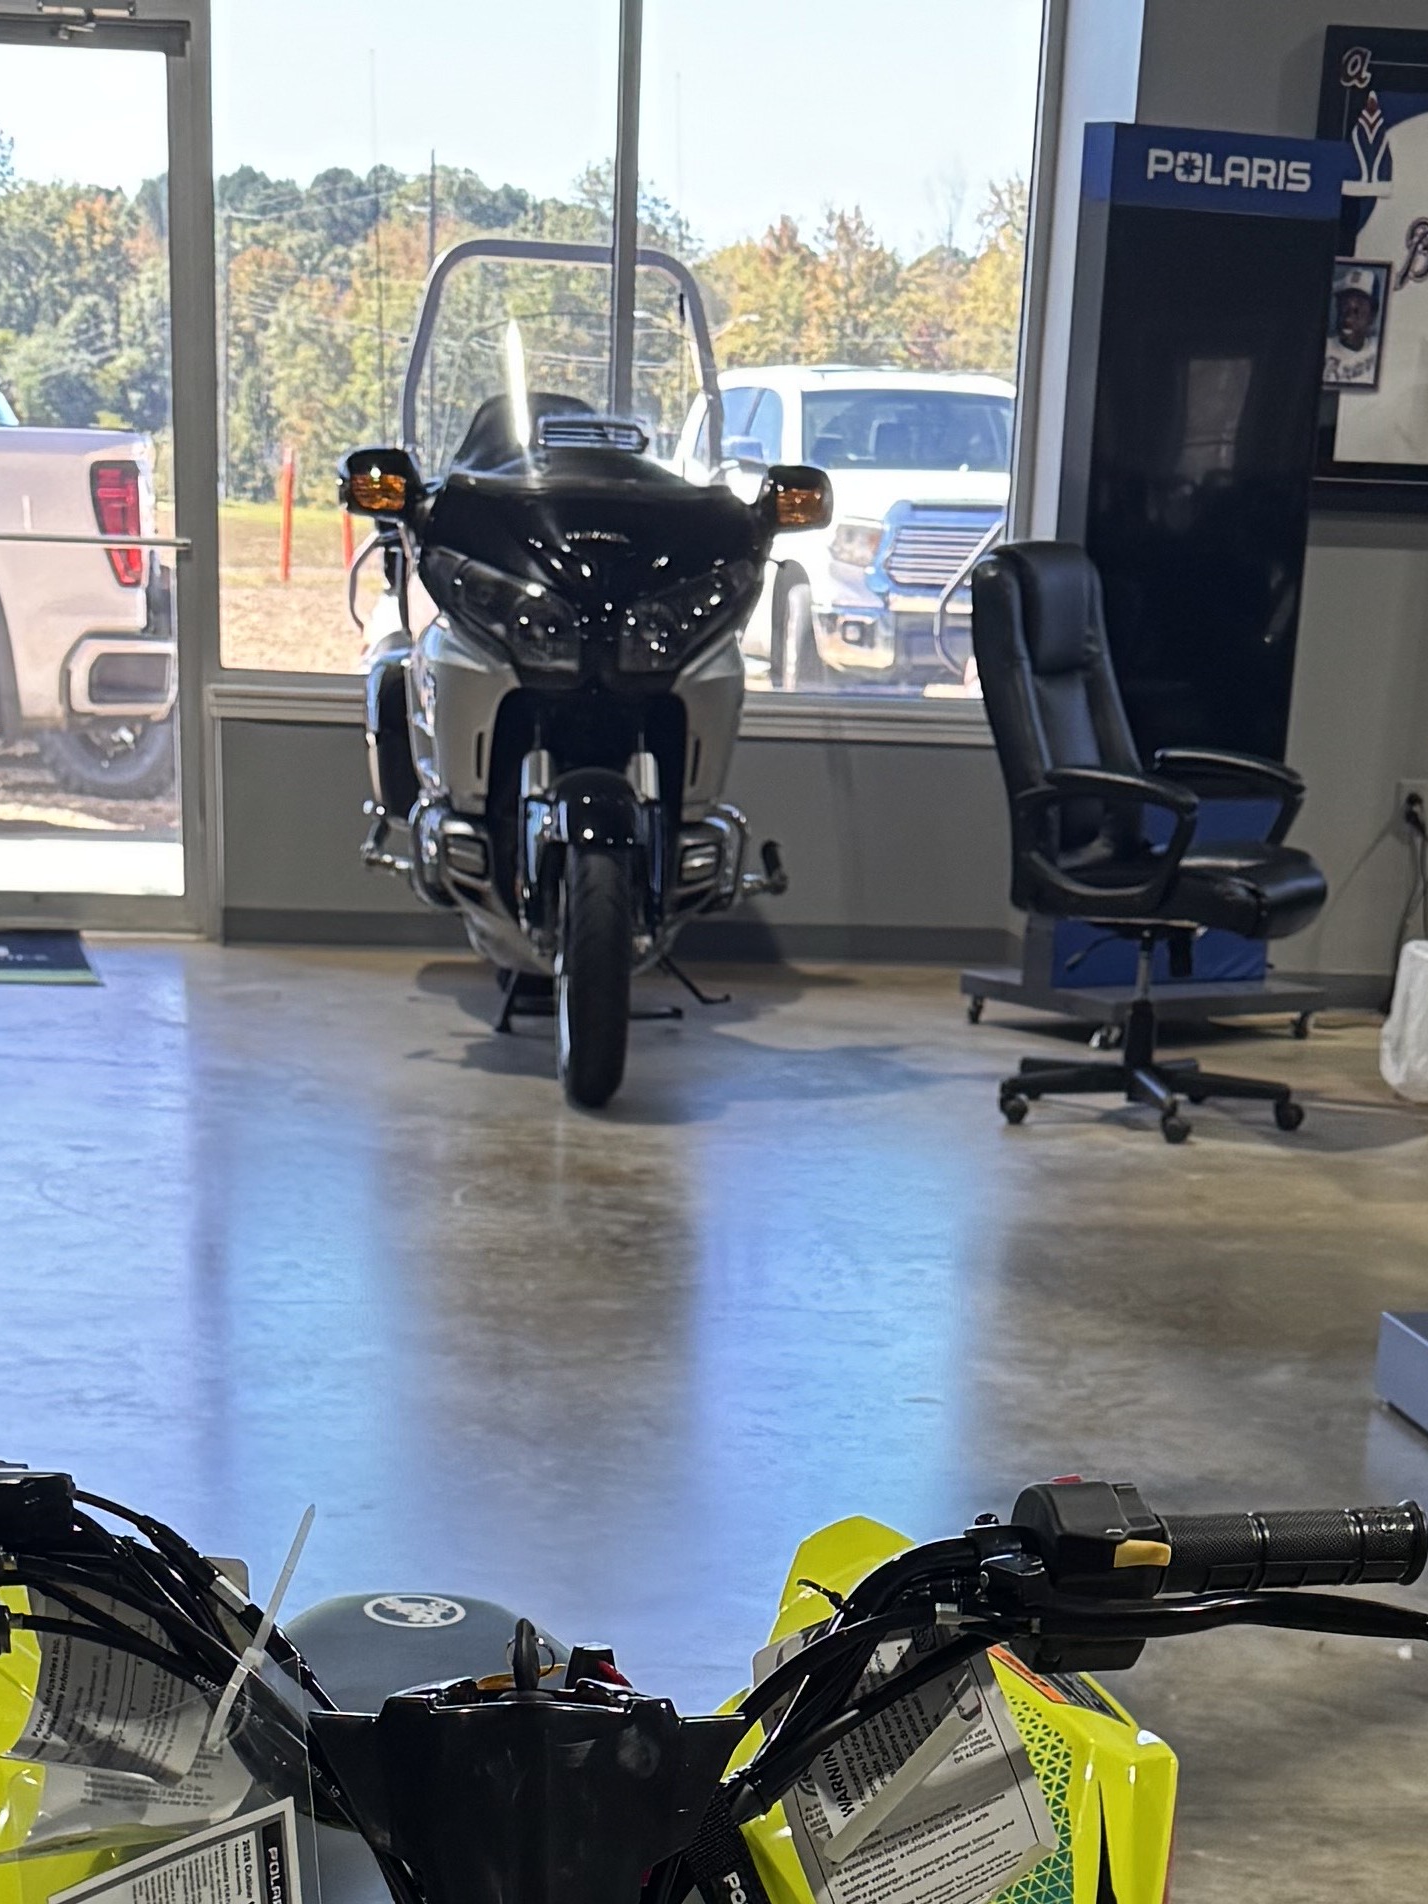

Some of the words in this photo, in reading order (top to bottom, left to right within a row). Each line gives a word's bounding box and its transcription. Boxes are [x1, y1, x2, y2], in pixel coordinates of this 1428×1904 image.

[1147, 148, 1311, 192] POLARIS
[44, 1658, 58, 1706] Industries
[822, 1750, 855, 1817] WARNIN
